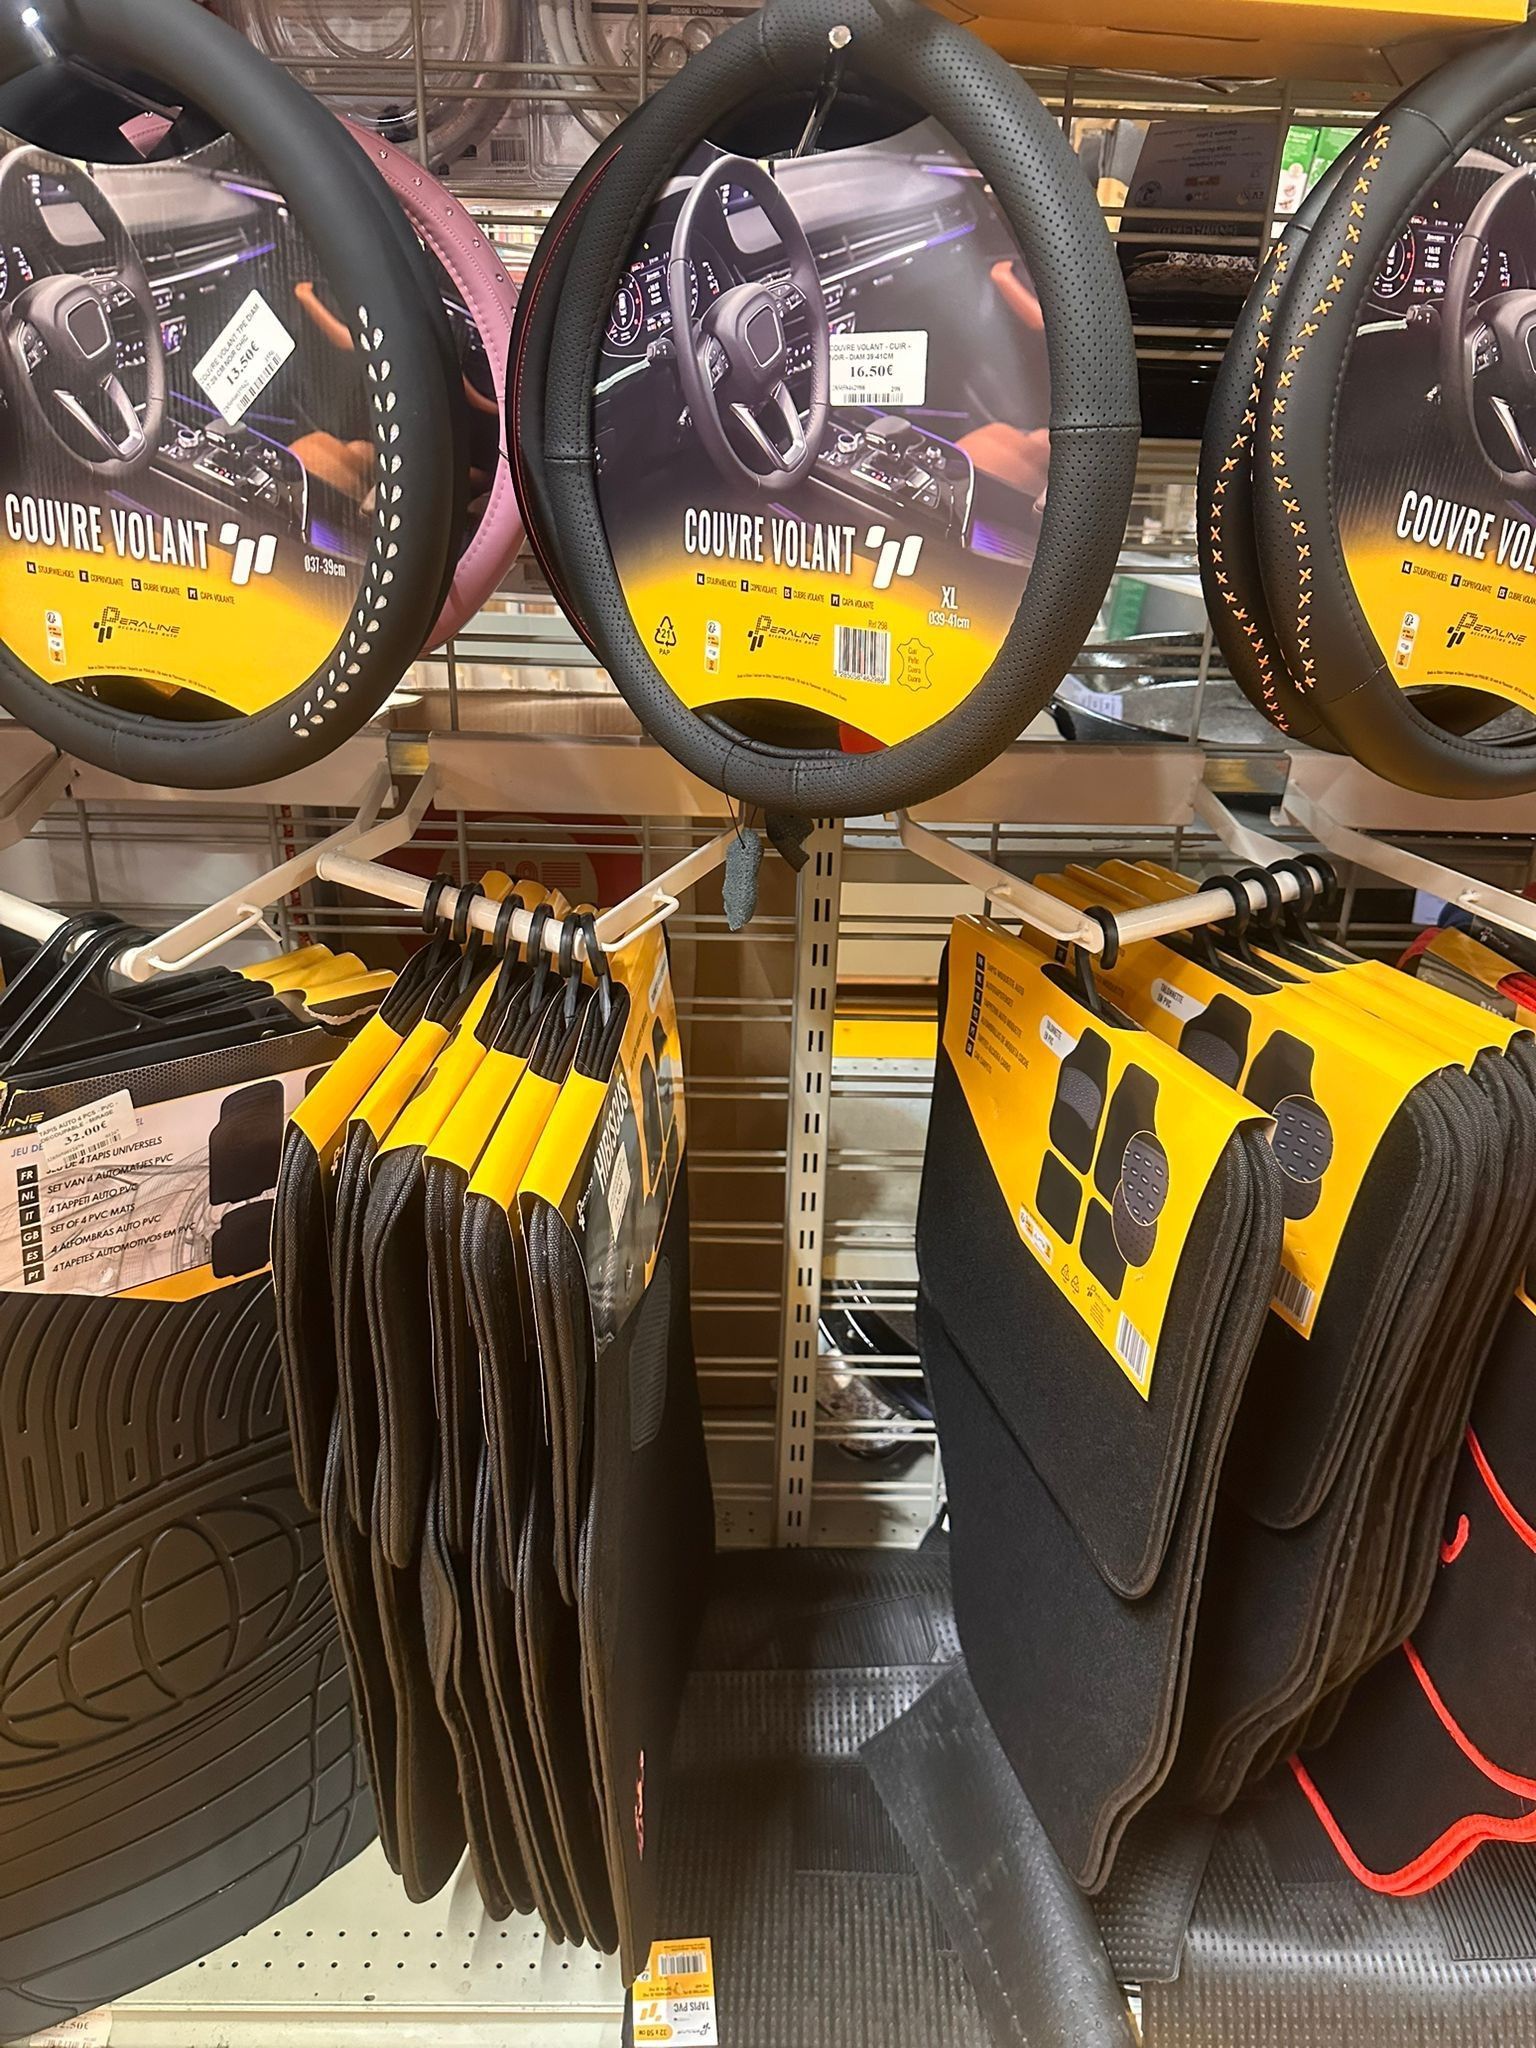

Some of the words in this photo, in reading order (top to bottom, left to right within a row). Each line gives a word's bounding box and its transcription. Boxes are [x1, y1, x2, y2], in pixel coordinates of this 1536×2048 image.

[220, 333, 238, 359] VOLANT
[246, 304, 260, 322] DIAM
[830, 344, 855, 352] COUVRE
[857, 343, 883, 351] VOLANT
[226, 341, 260, 385] 13.50€
[851, 364, 893, 378] 16.50€
[5, 493, 104, 555] COUVRE
[110, 508, 209, 570] VOLANT
[1396, 490, 1496, 560] COUVRE
[1496, 518, 1536, 575] VOL
[684, 508, 764, 563] COUVRE
[772, 518, 856, 576] VOLANT
[90, 574, 125, 587] COPRIVOLANTE
[143, 583, 159, 592] CUBRE
[160, 586, 181, 596] VOLANTE
[200, 592, 214, 601] CAPA
[214, 594, 236, 605] VOLANTE
[941, 586, 959, 610] XL
[1508, 591, 1522, 602] CUBRE
[807, 593, 825, 603] VOLANTE
[842, 598, 854, 607] CAPA
[855, 600, 874, 610] VOLANTE
[102, 606, 181, 635] PERALINE
[755, 615, 821, 643] PERALINE
[868, 620, 877, 629] Ref
[878, 621, 888, 631] 298
[1456, 612, 1527, 642] PERALINE
[161, 630, 178, 639] auto
[661, 629, 671, 639] 21
[659, 648, 671, 656] PAP
[1163, 997, 1171, 1009] PVC
[39, 1126, 58, 1137] TAPIS
[59, 1118, 76, 1129] AUTO
[82, 1110, 97, 1120] PCS
[101, 1103, 115, 1113] PVC
[89, 1109, 114, 1124] MIRAGE
[65, 1121, 108, 1146] 32.00€
[594, 1072, 629, 1196] HIBISCUS
[11, 1147, 29, 1158] JEU
[31, 1143, 44, 1153] DE
[79, 1157, 85, 1165] 4
[85, 1150, 111, 1164] TAPIS
[112, 1136, 163, 1157] UNIVERSELS
[21, 1170, 34, 1181] FR
[47, 1183, 63, 1194] SET
[64, 1177, 86, 1189] VAN
[87, 1174, 94, 1183] 4
[95, 1158, 153, 1182] AUTOMATJES
[155, 1153, 174, 1165] PVC
[22, 1191, 36, 1202] NL
[49, 1205, 55, 1214] 4
[56, 1196, 90, 1211] TAPPETI
[93, 1189, 118, 1202] AUTO
[119, 1183, 139, 1195] PVC
[25, 1211, 35, 1221] IT
[50, 1224, 65, 1235] SET
[66, 1218, 80, 1229] OF
[81, 1216, 87, 1224] 4
[88, 1210, 109, 1223] PVC
[110, 1203, 135, 1217] MATS
[23, 1231, 40, 1242] GB
[51, 1245, 58, 1254] 4
[60, 1228, 114, 1250] ALFOMBRAS
[115, 1221, 141, 1234] AUTO
[142, 1214, 162, 1226] PVC
[27, 1251, 39, 1261] ES
[52, 1264, 59, 1273] 4
[60, 1253, 94, 1270] TAPETES
[96, 1233, 162, 1259] AUTOMOTIVOS
[164, 1229, 177, 1239] EM
[178, 1222, 196, 1234] PVC
[28, 1270, 40, 1281] PT
[674, 2002, 688, 2013] PVC
[690, 2001, 710, 2012] TAPIS
[646, 2029, 654, 2037] 50
